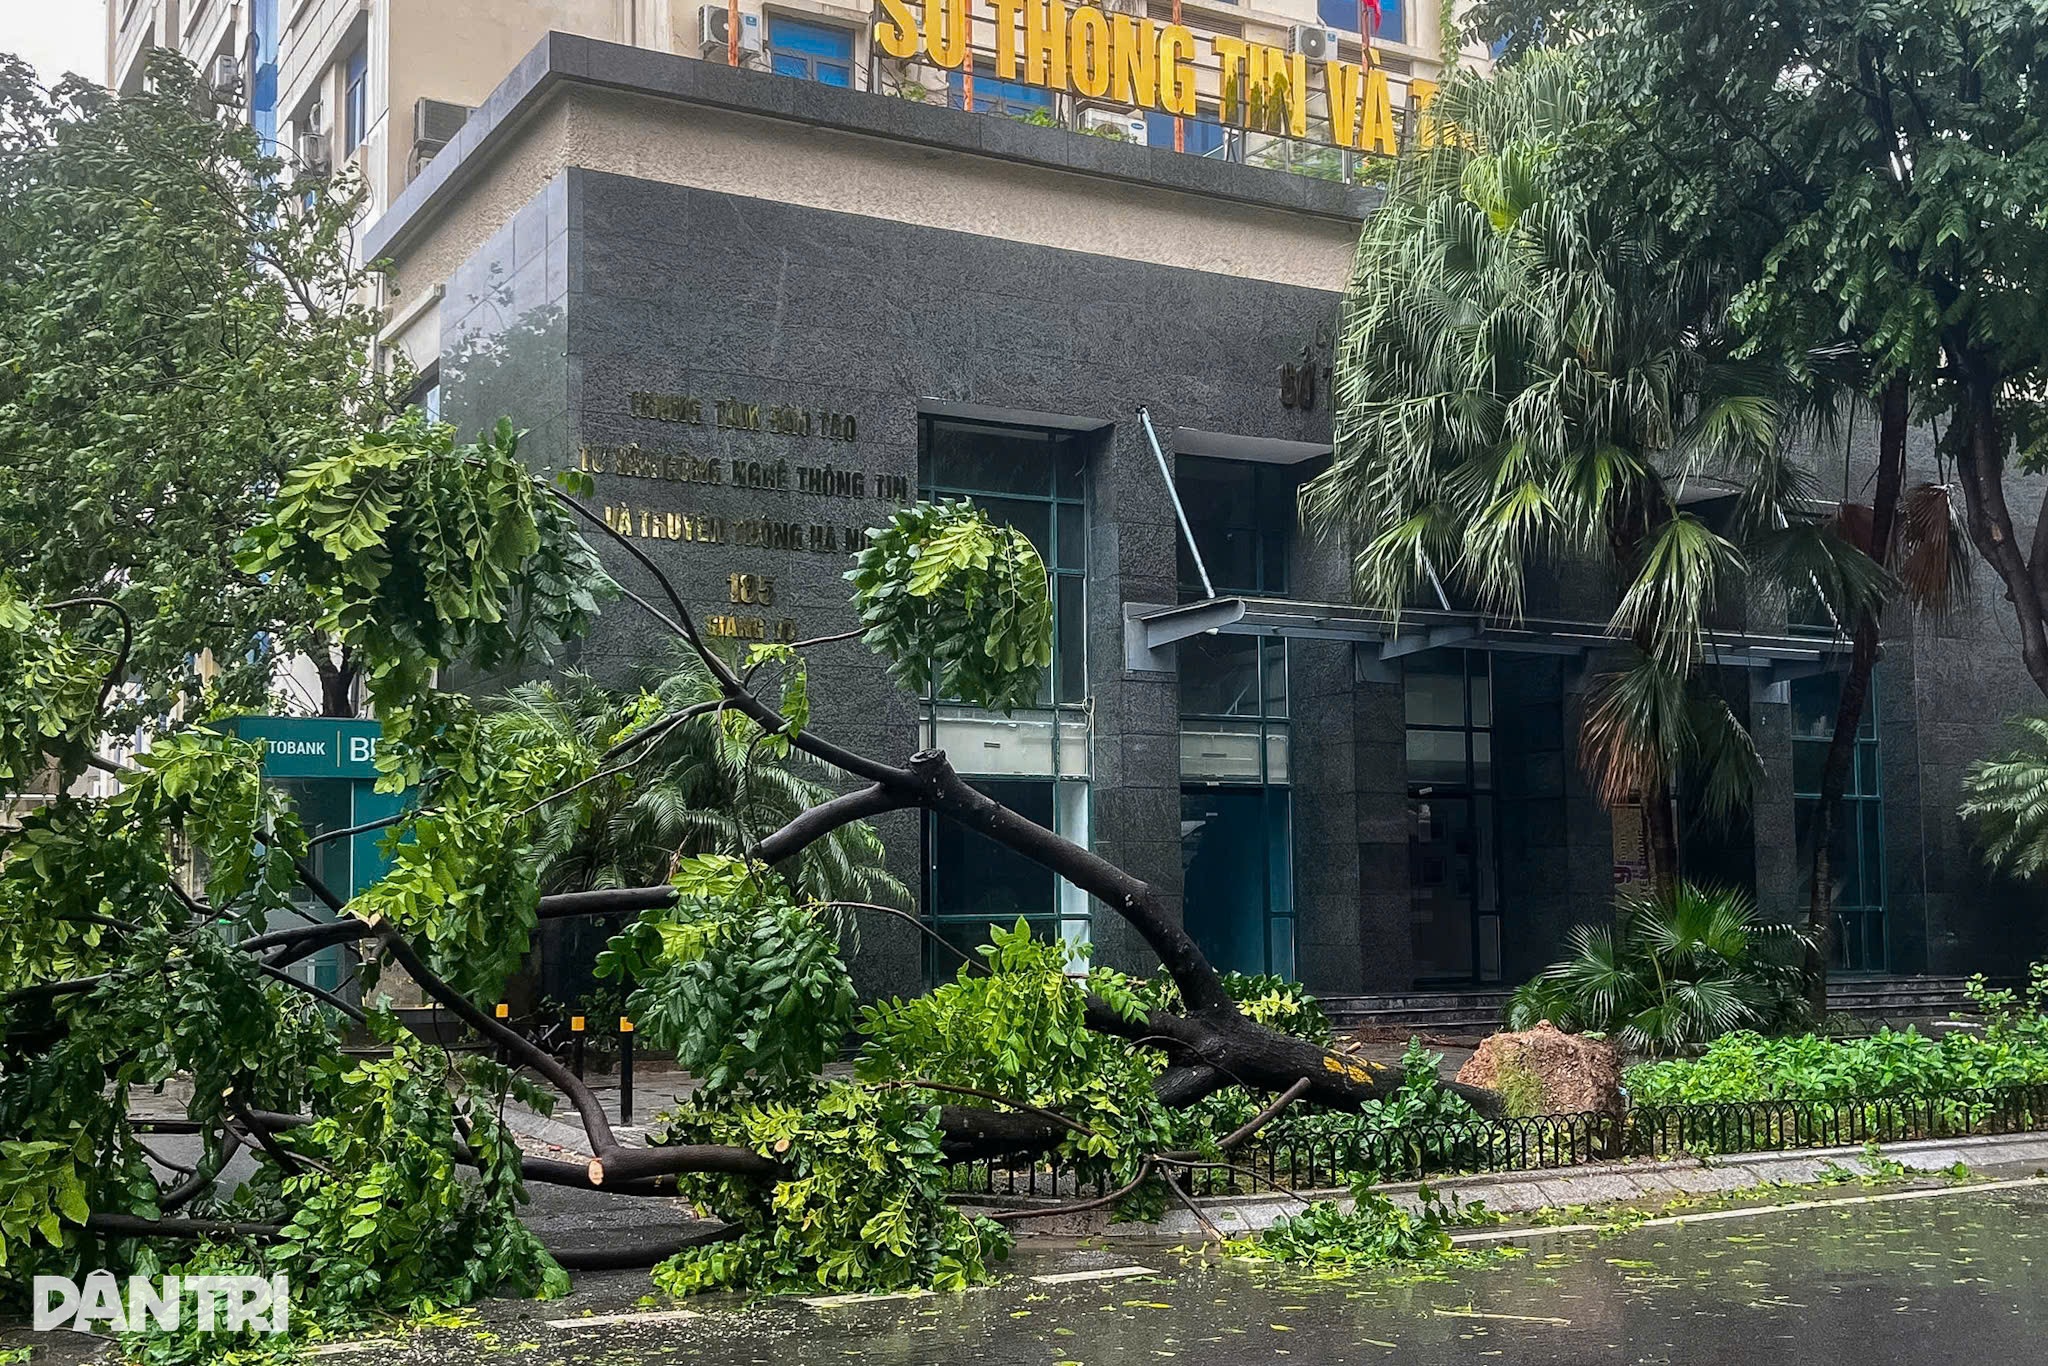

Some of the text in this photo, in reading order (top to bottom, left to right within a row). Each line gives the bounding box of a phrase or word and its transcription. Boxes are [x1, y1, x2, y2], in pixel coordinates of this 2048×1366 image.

[1211, 35, 1306, 138] TIN
[1323, 47, 1397, 156] VÀ
[874, 473, 908, 501] TIN
[604, 501, 633, 537] VÀ
[268, 740, 326, 756] TOBANK
